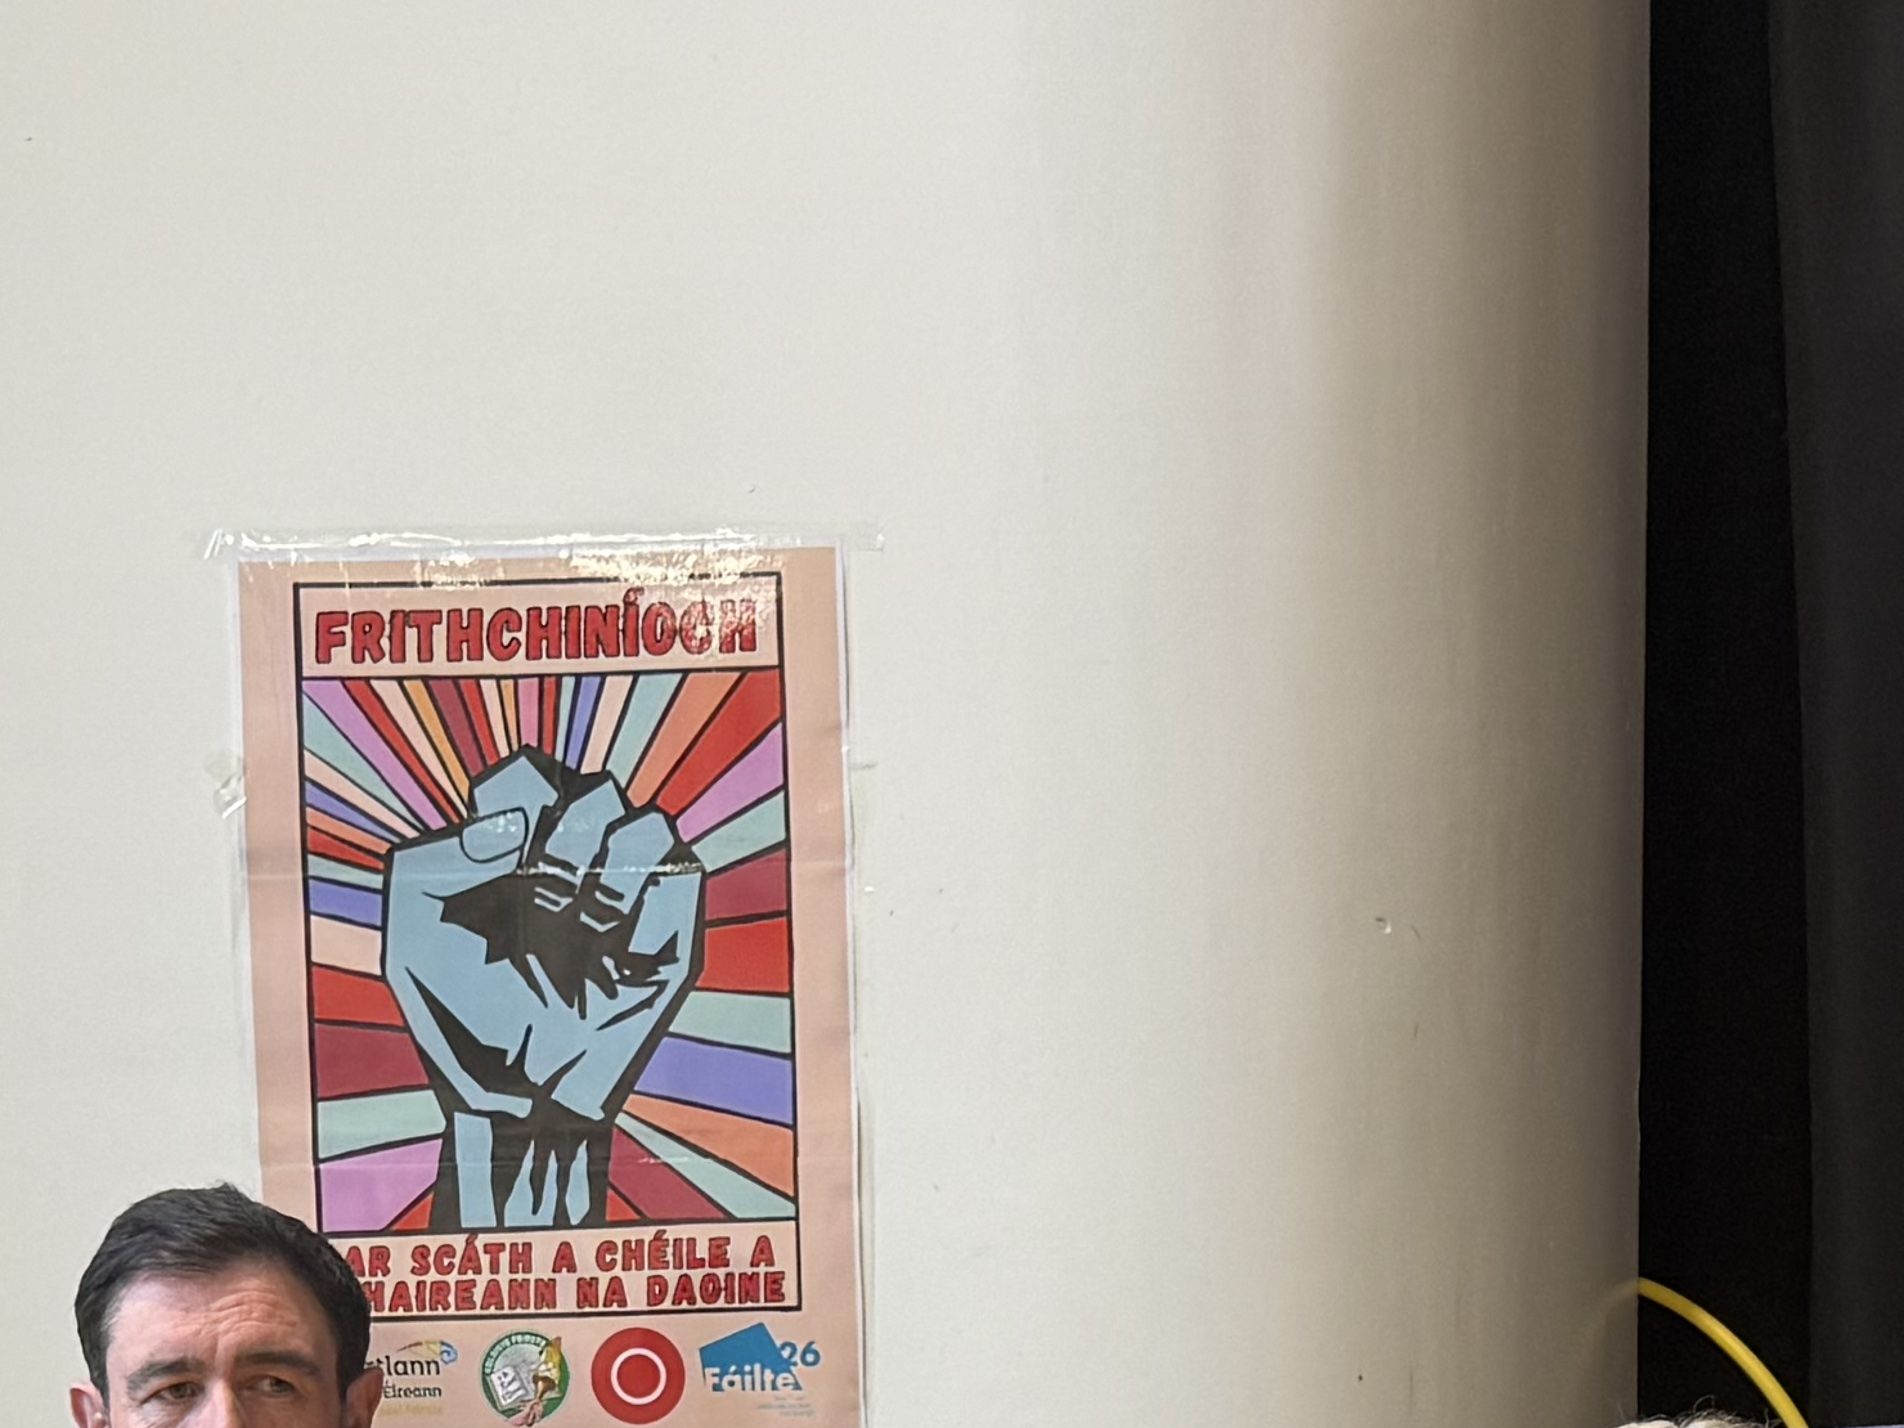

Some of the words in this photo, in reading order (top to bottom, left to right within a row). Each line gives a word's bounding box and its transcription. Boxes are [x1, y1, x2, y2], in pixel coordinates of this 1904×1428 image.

[314, 588, 758, 666] FRITHCHINÍOCH
[410, 1234, 531, 1276] SCÁTH
[553, 1241, 577, 1274] A
[595, 1231, 730, 1272] CHÉILE
[750, 1236, 776, 1268] A
[362, 1277, 558, 1312] HAIREANN
[577, 1275, 626, 1309] NA
[646, 1270, 786, 1306] DAOINE
[704, 1363, 795, 1391] Fáilte
